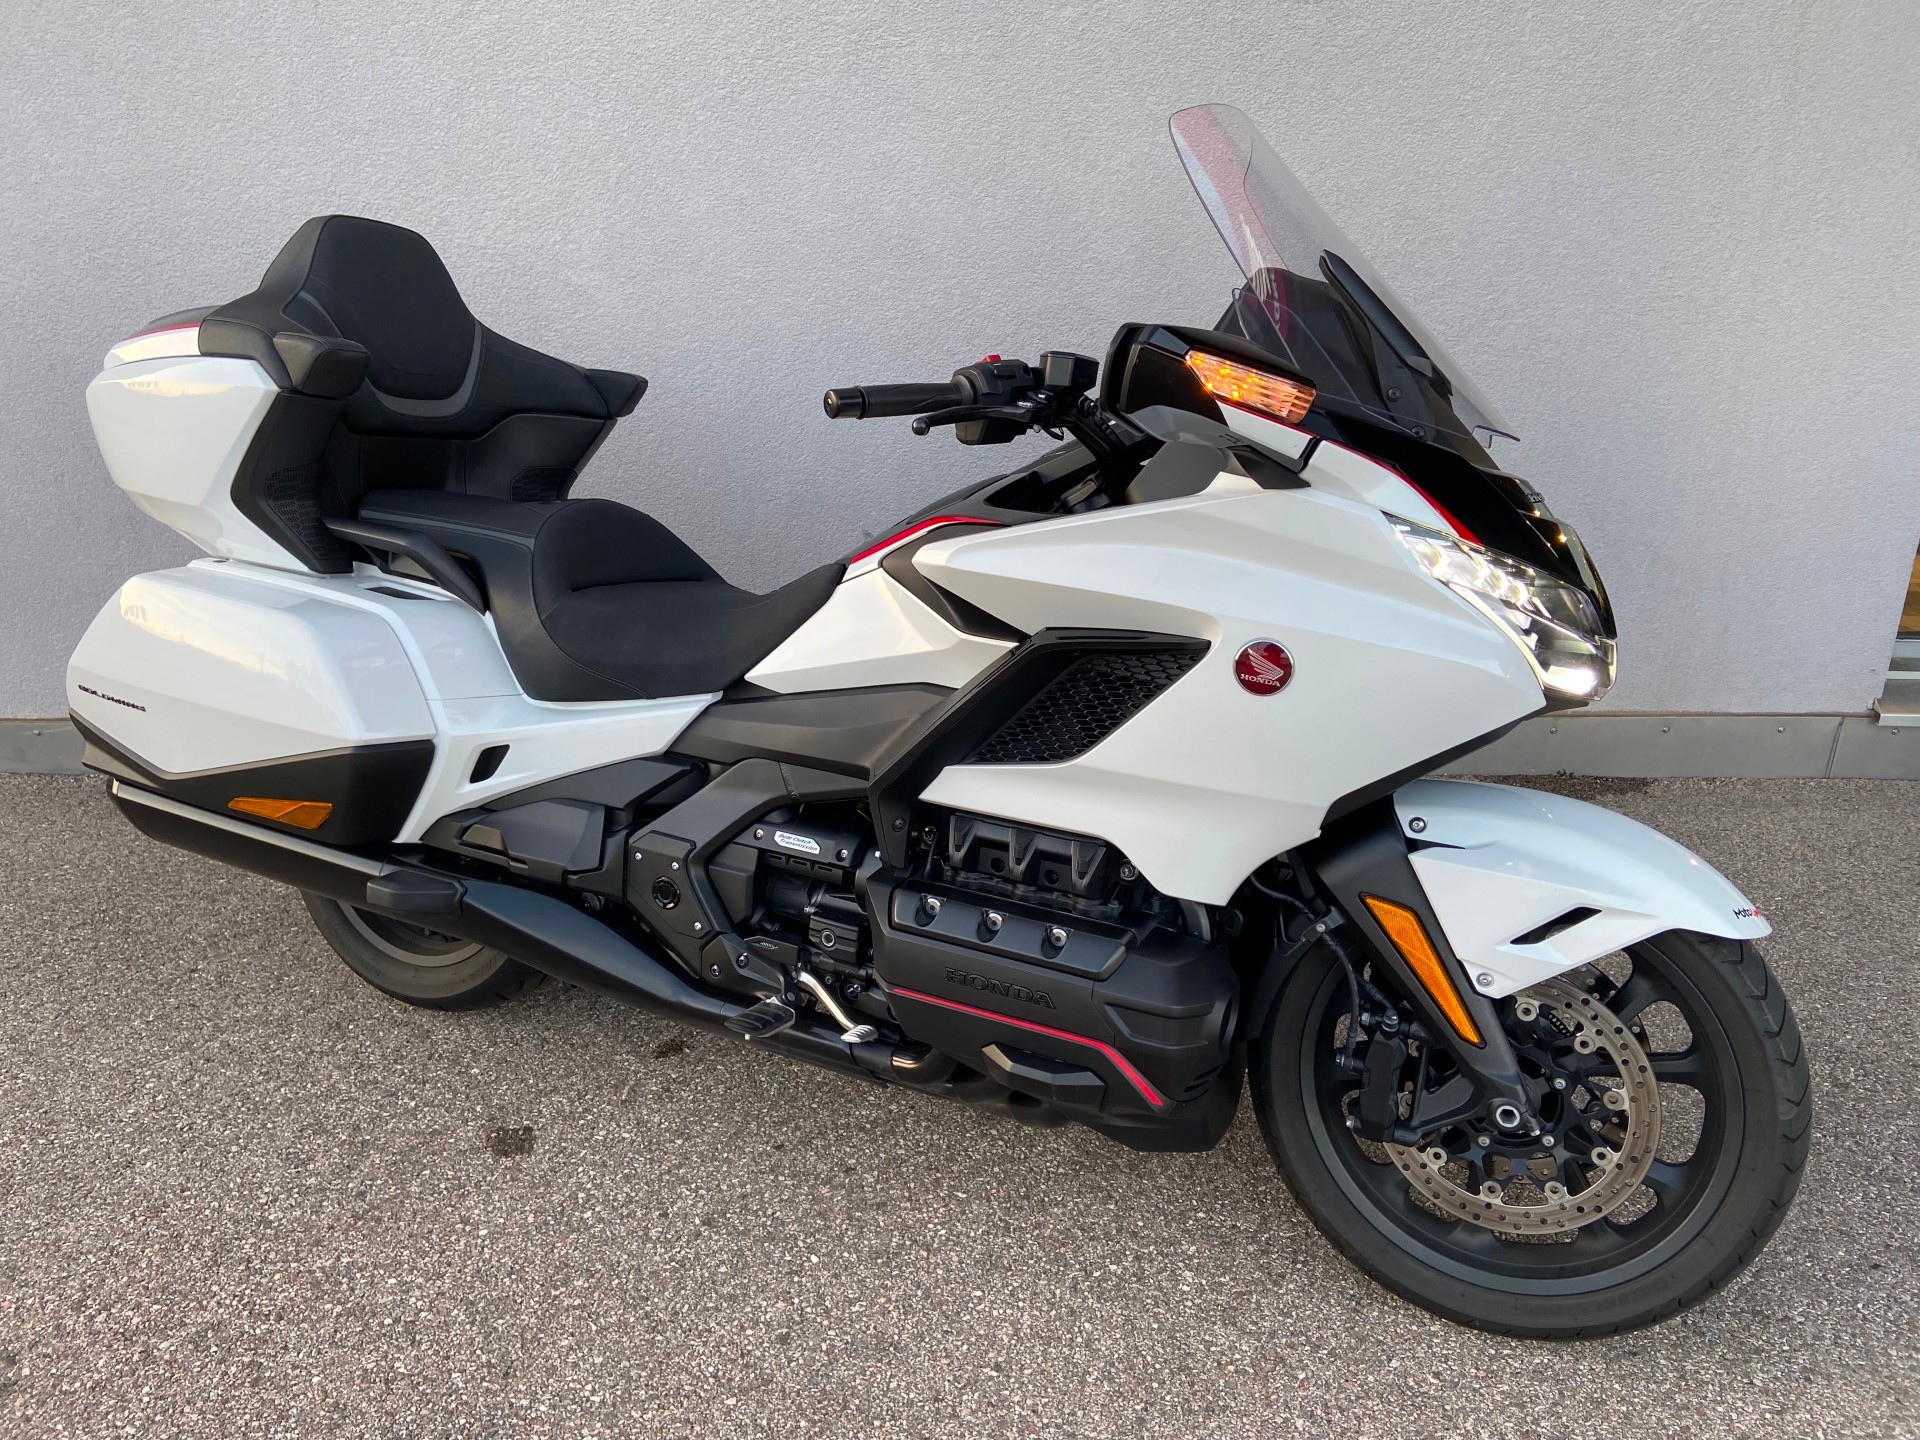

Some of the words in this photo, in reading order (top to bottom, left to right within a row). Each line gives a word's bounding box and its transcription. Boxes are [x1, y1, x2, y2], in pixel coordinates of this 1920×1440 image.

[1240, 673, 1281, 687] HONDA
[780, 838, 818, 851] Transmission
[793, 837, 812, 845] Clutch
[945, 967, 1057, 1010] HONDA
